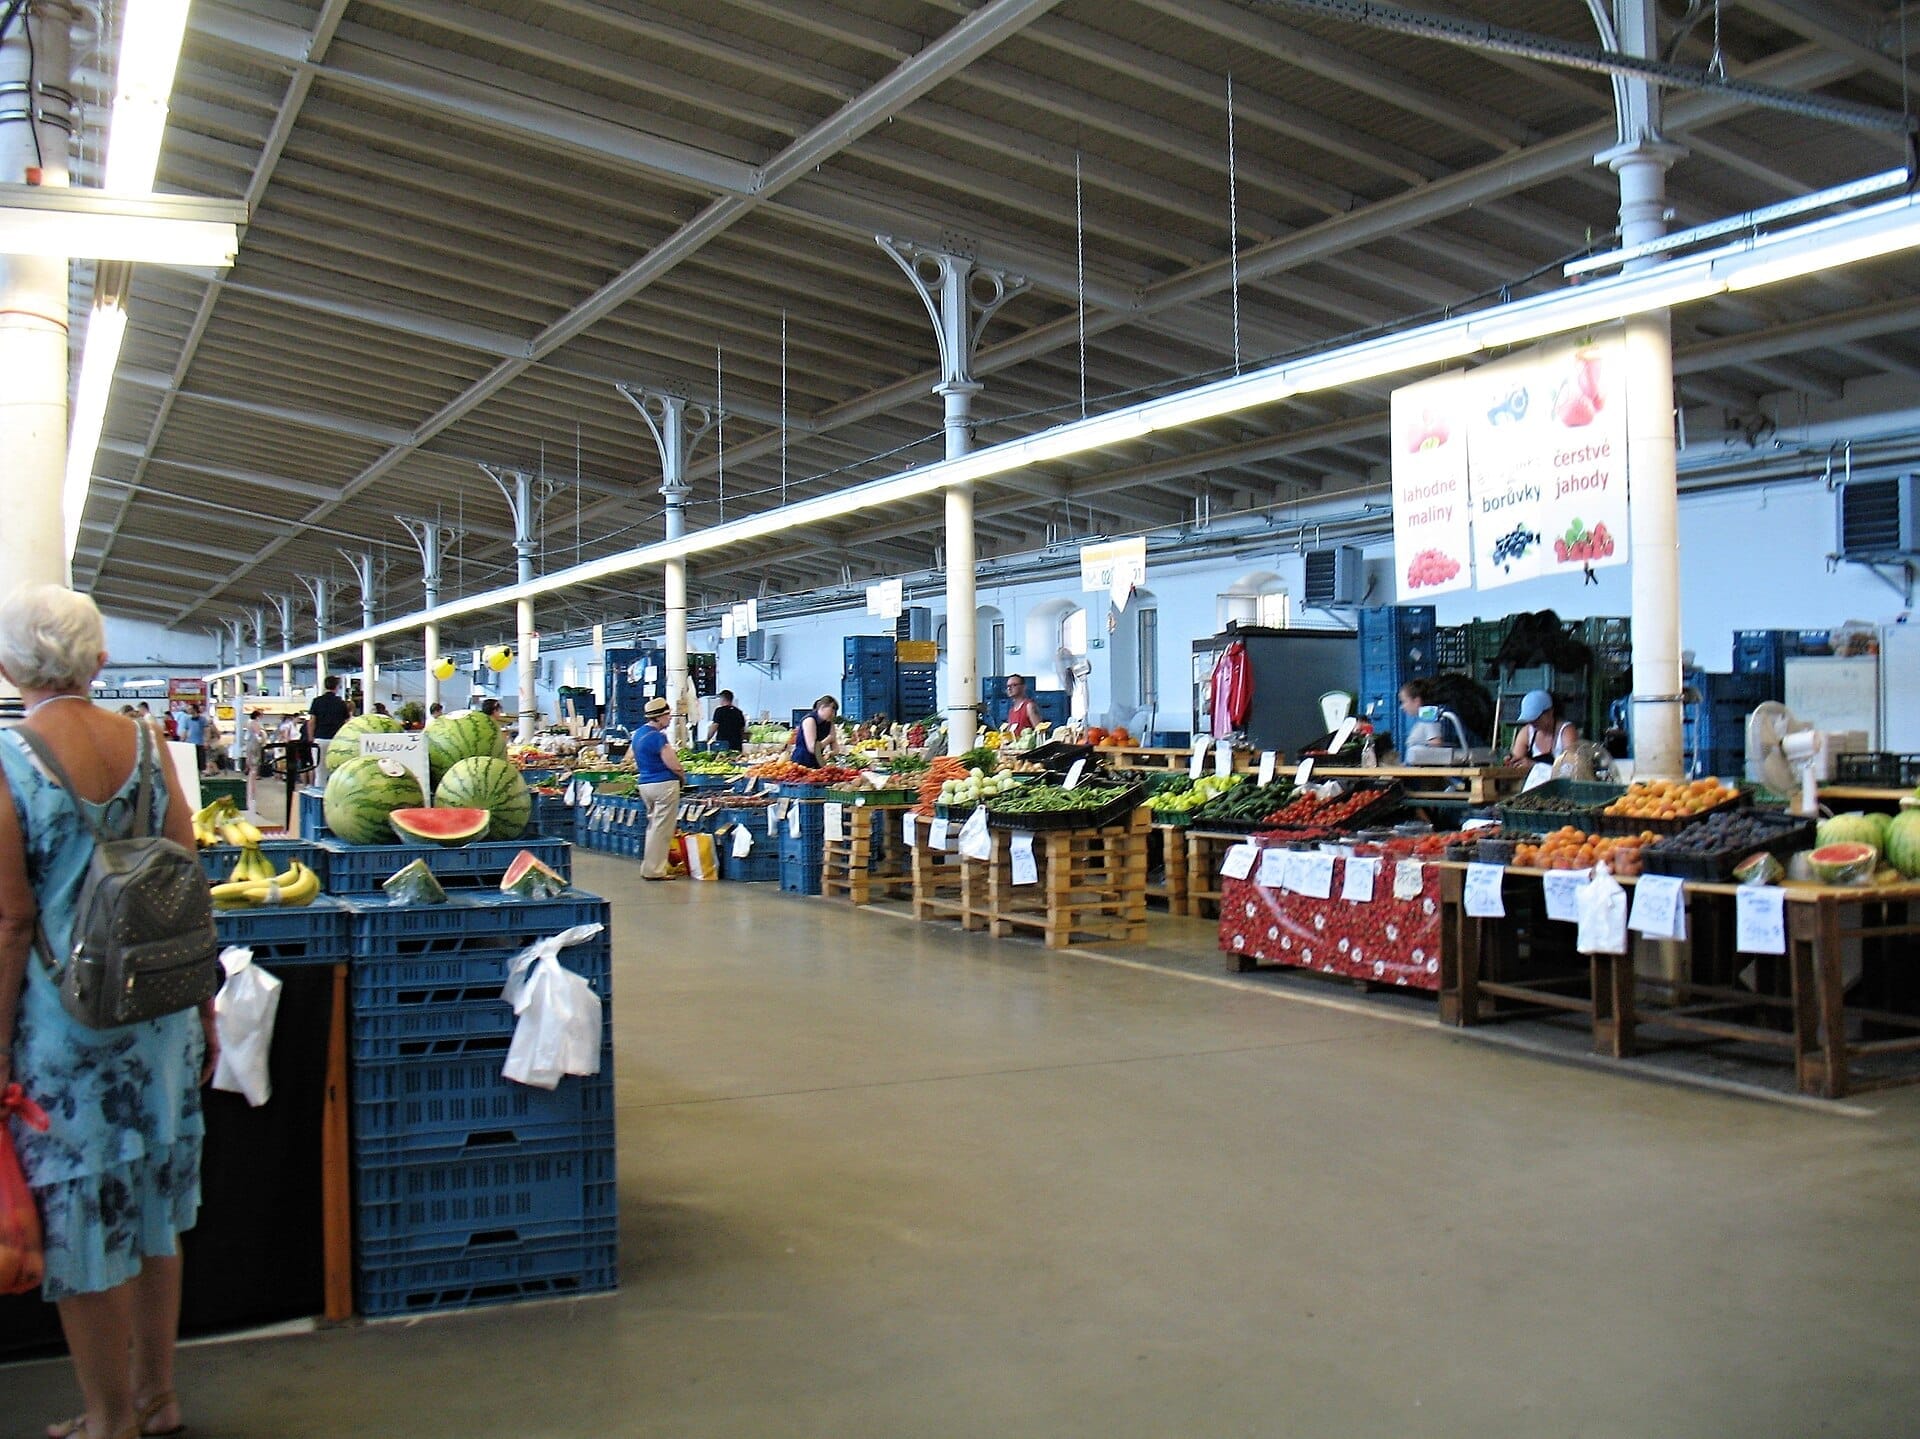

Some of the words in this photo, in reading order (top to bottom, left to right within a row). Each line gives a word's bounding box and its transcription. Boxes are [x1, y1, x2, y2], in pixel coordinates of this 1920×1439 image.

[1553, 437, 1611, 468] čerstvé
[1403, 473, 1457, 504] lahodné
[1482, 483, 1541, 513] borůvky
[1554, 469, 1610, 500] jahody
[1408, 503, 1454, 528] maliny
